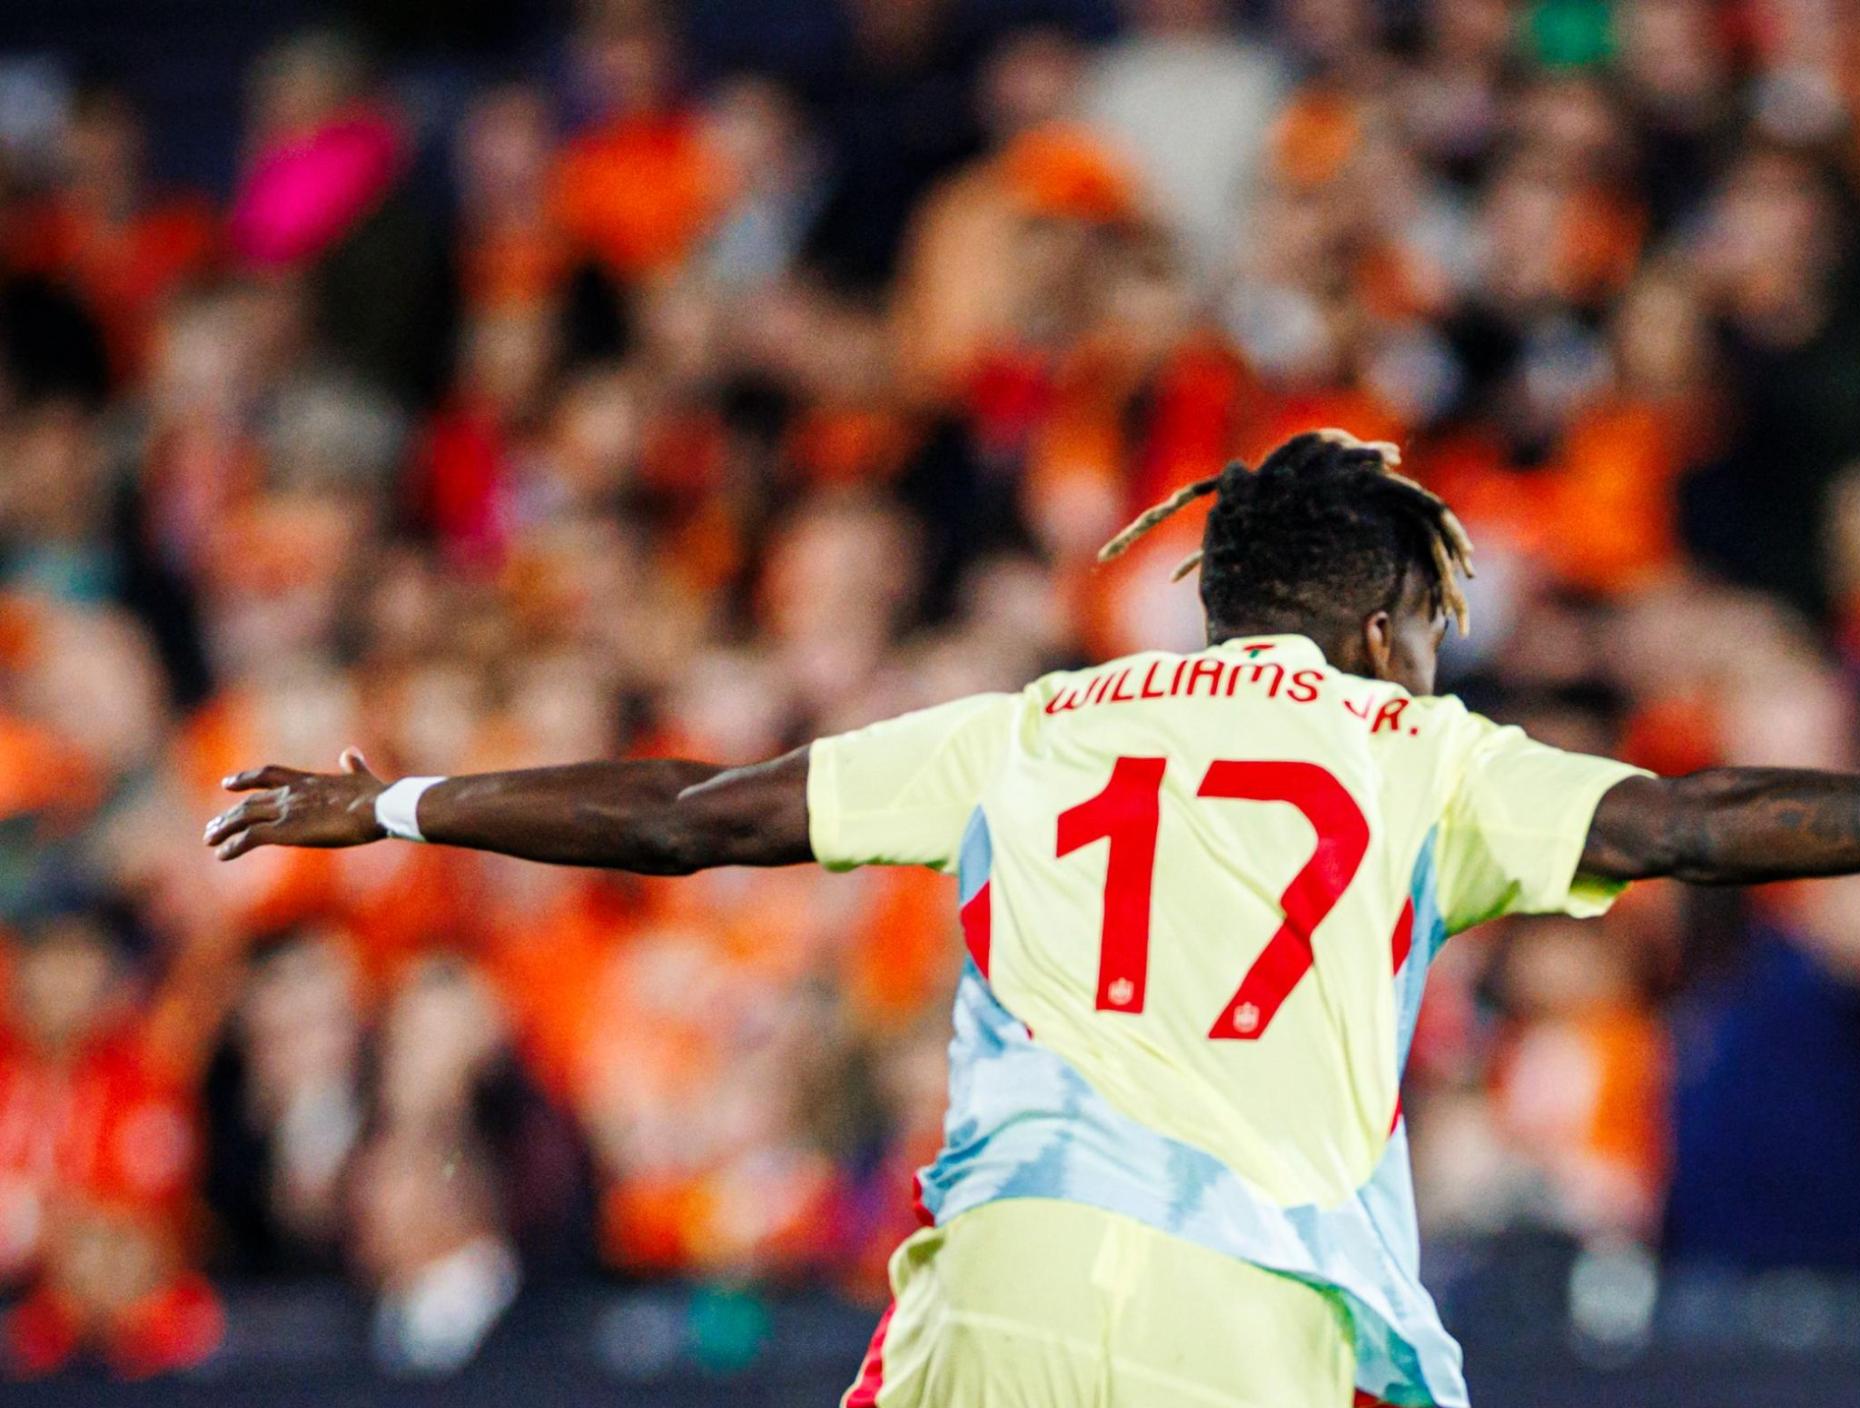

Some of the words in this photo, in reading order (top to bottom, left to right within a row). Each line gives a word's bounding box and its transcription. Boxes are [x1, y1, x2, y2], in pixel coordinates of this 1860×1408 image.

[1045, 657, 1325, 716] WILLIAMS
[1343, 692, 1419, 735] JR.
[1055, 756, 1370, 1040] 17
